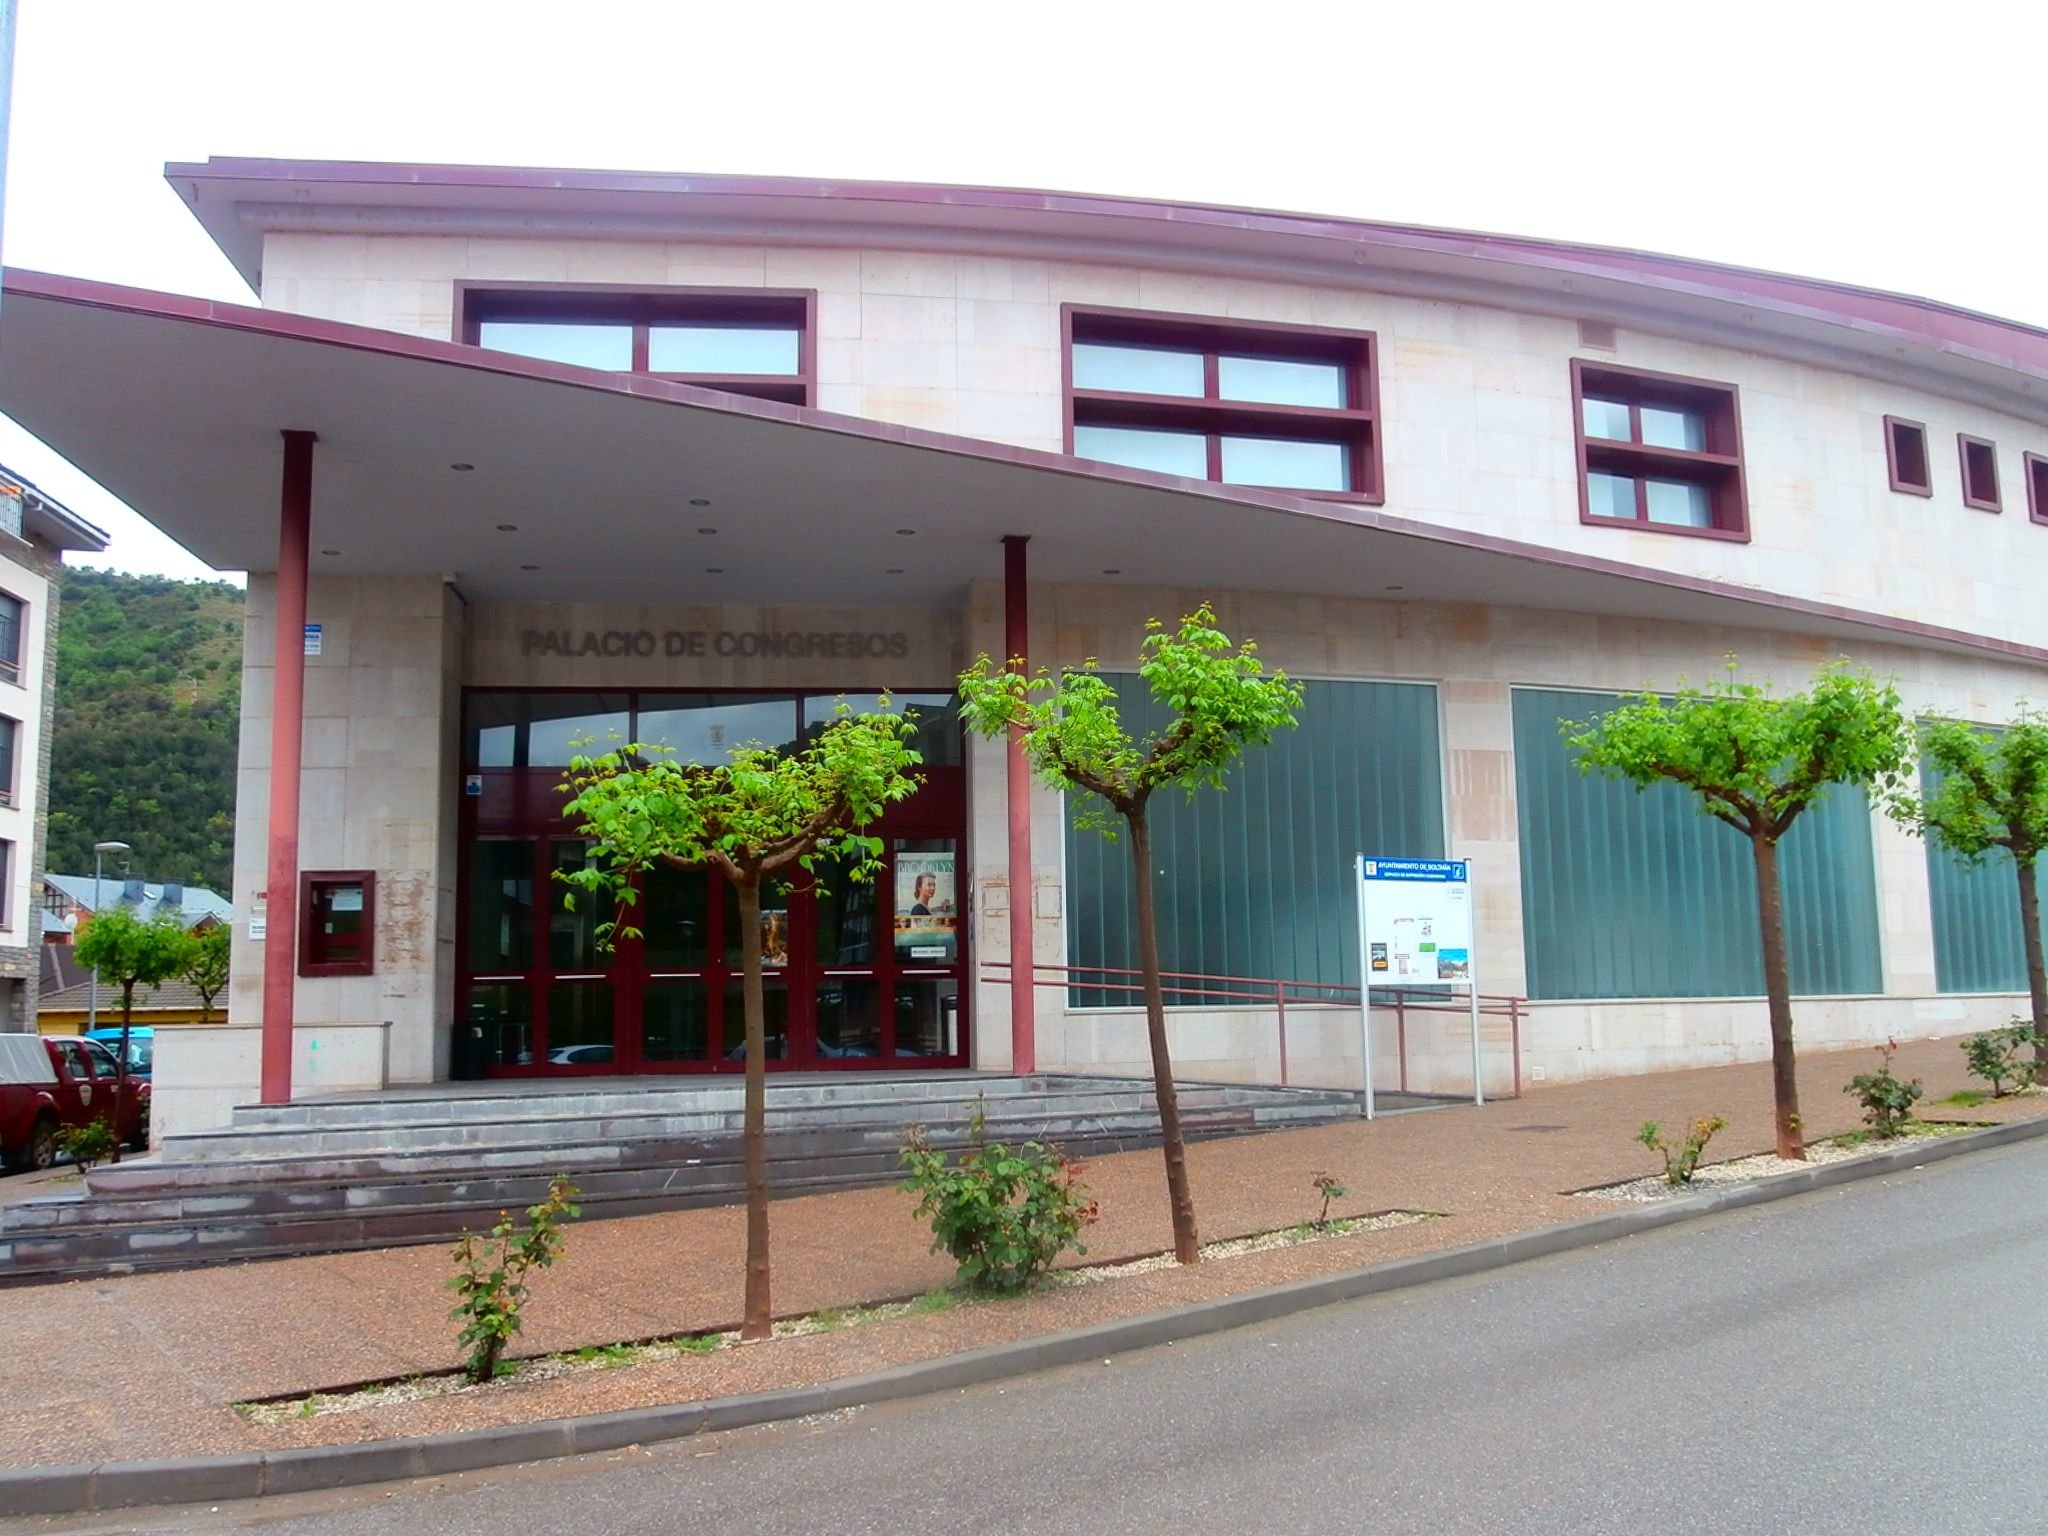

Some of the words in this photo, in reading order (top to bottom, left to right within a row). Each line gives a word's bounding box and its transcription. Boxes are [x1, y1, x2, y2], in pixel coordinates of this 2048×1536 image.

[521, 630, 657, 657] PALACIO
[664, 631, 706, 657] DE
[715, 631, 909, 658] CONGRESOS
[898, 862, 954, 873] BROOKLYN
[1378, 862, 1419, 870] AYUNTAMIENTO
